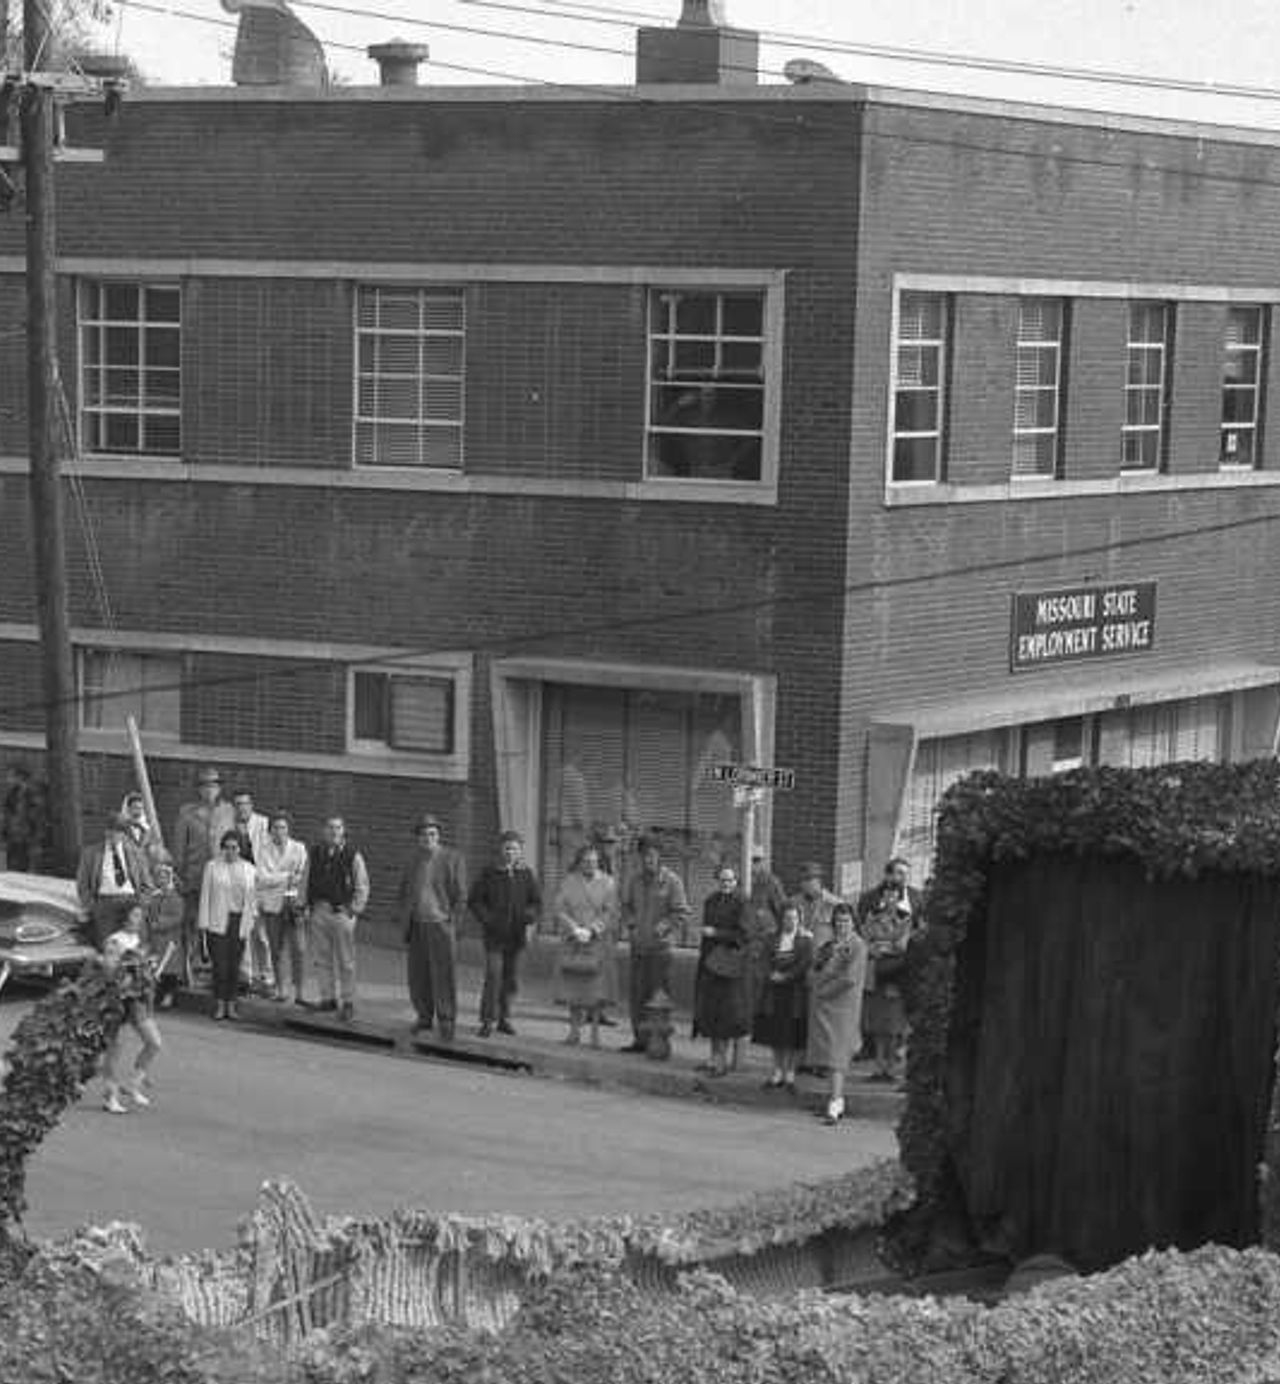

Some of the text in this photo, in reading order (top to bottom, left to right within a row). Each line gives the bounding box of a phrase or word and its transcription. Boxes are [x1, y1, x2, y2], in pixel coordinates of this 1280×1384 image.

[1036, 589, 1138, 626] MISSOURI STATE
[1018, 619, 1151, 661] EMPLOYMENT SERVICE
